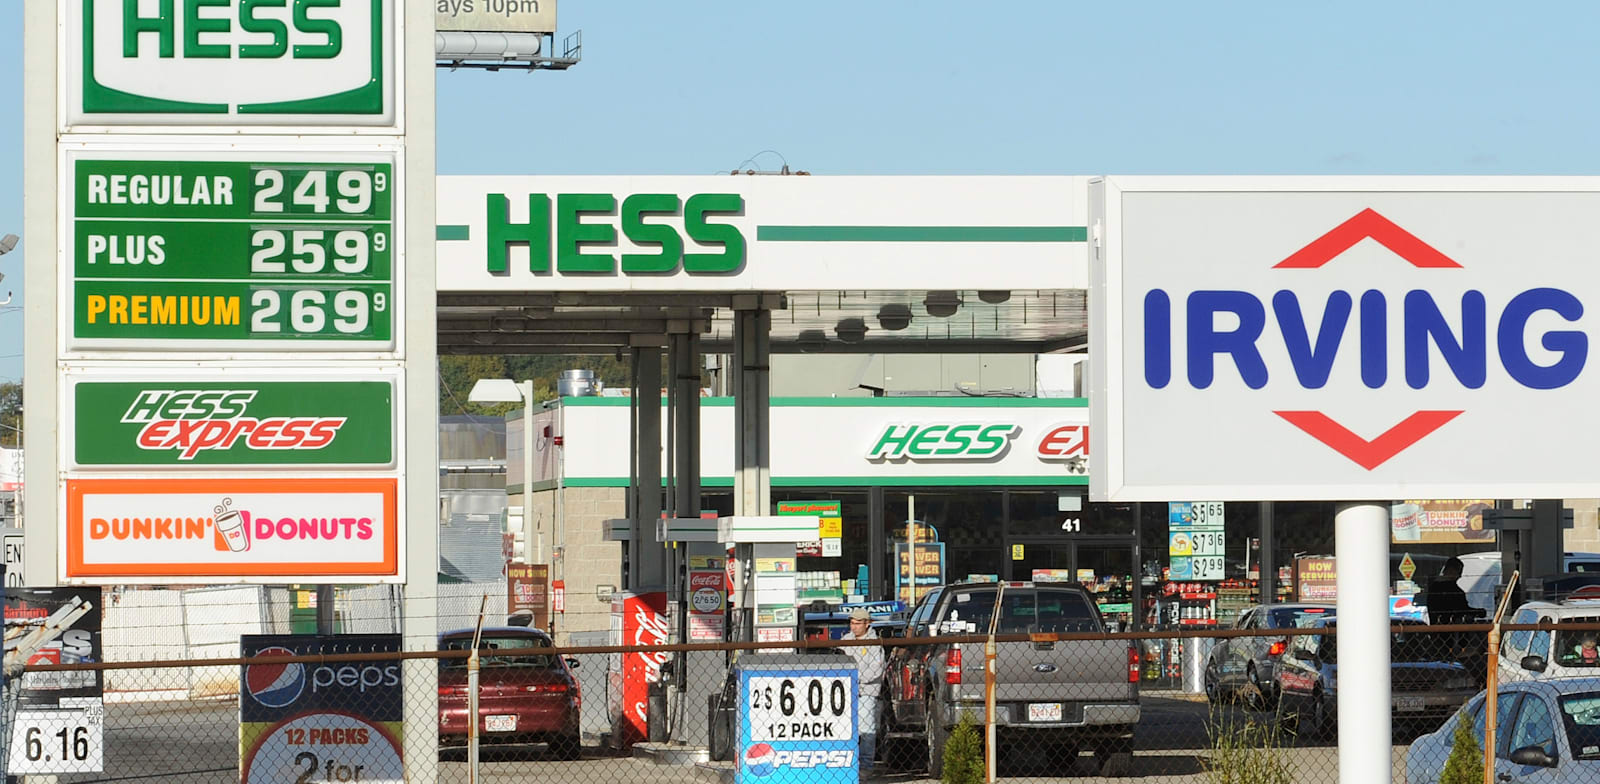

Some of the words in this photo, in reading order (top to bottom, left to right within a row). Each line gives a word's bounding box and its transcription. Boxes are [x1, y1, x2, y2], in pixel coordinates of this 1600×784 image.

[484, 0, 539, 17] 10pm
[122, 0, 342, 58] HESS
[88, 174, 234, 206] REGULAR
[253, 169, 372, 213] 249
[487, 193, 747, 276] HESS
[87, 235, 166, 265] PLUS
[251, 230, 370, 274] 259
[87, 295, 241, 326] PREMIUM
[251, 289, 370, 333] 269
[1144, 287, 1589, 390] IRVING
[121, 390, 258, 422] HESS
[868, 424, 1018, 460] HESS
[90, 517, 213, 540] DUNKIN'
[255, 517, 374, 540] DONUTS
[1062, 518, 1081, 532] 41
[1430, 519, 1467, 527] DONUTS
[6, 544, 24, 563] EN
[900, 551, 940, 562] TWER
[900, 564, 940, 575] PWER
[1308, 563, 1332, 571] NOW
[85, 706, 102, 715] PLUS
[285, 729, 307, 745] 12
[310, 728, 369, 745] PACKS
[769, 724, 786, 738] 12
[792, 722, 833, 738] PACK
[26, 727, 88, 762] 6.16
[294, 751, 319, 784] 2
[325, 759, 364, 782] for
[774, 750, 854, 768] PEPSI
